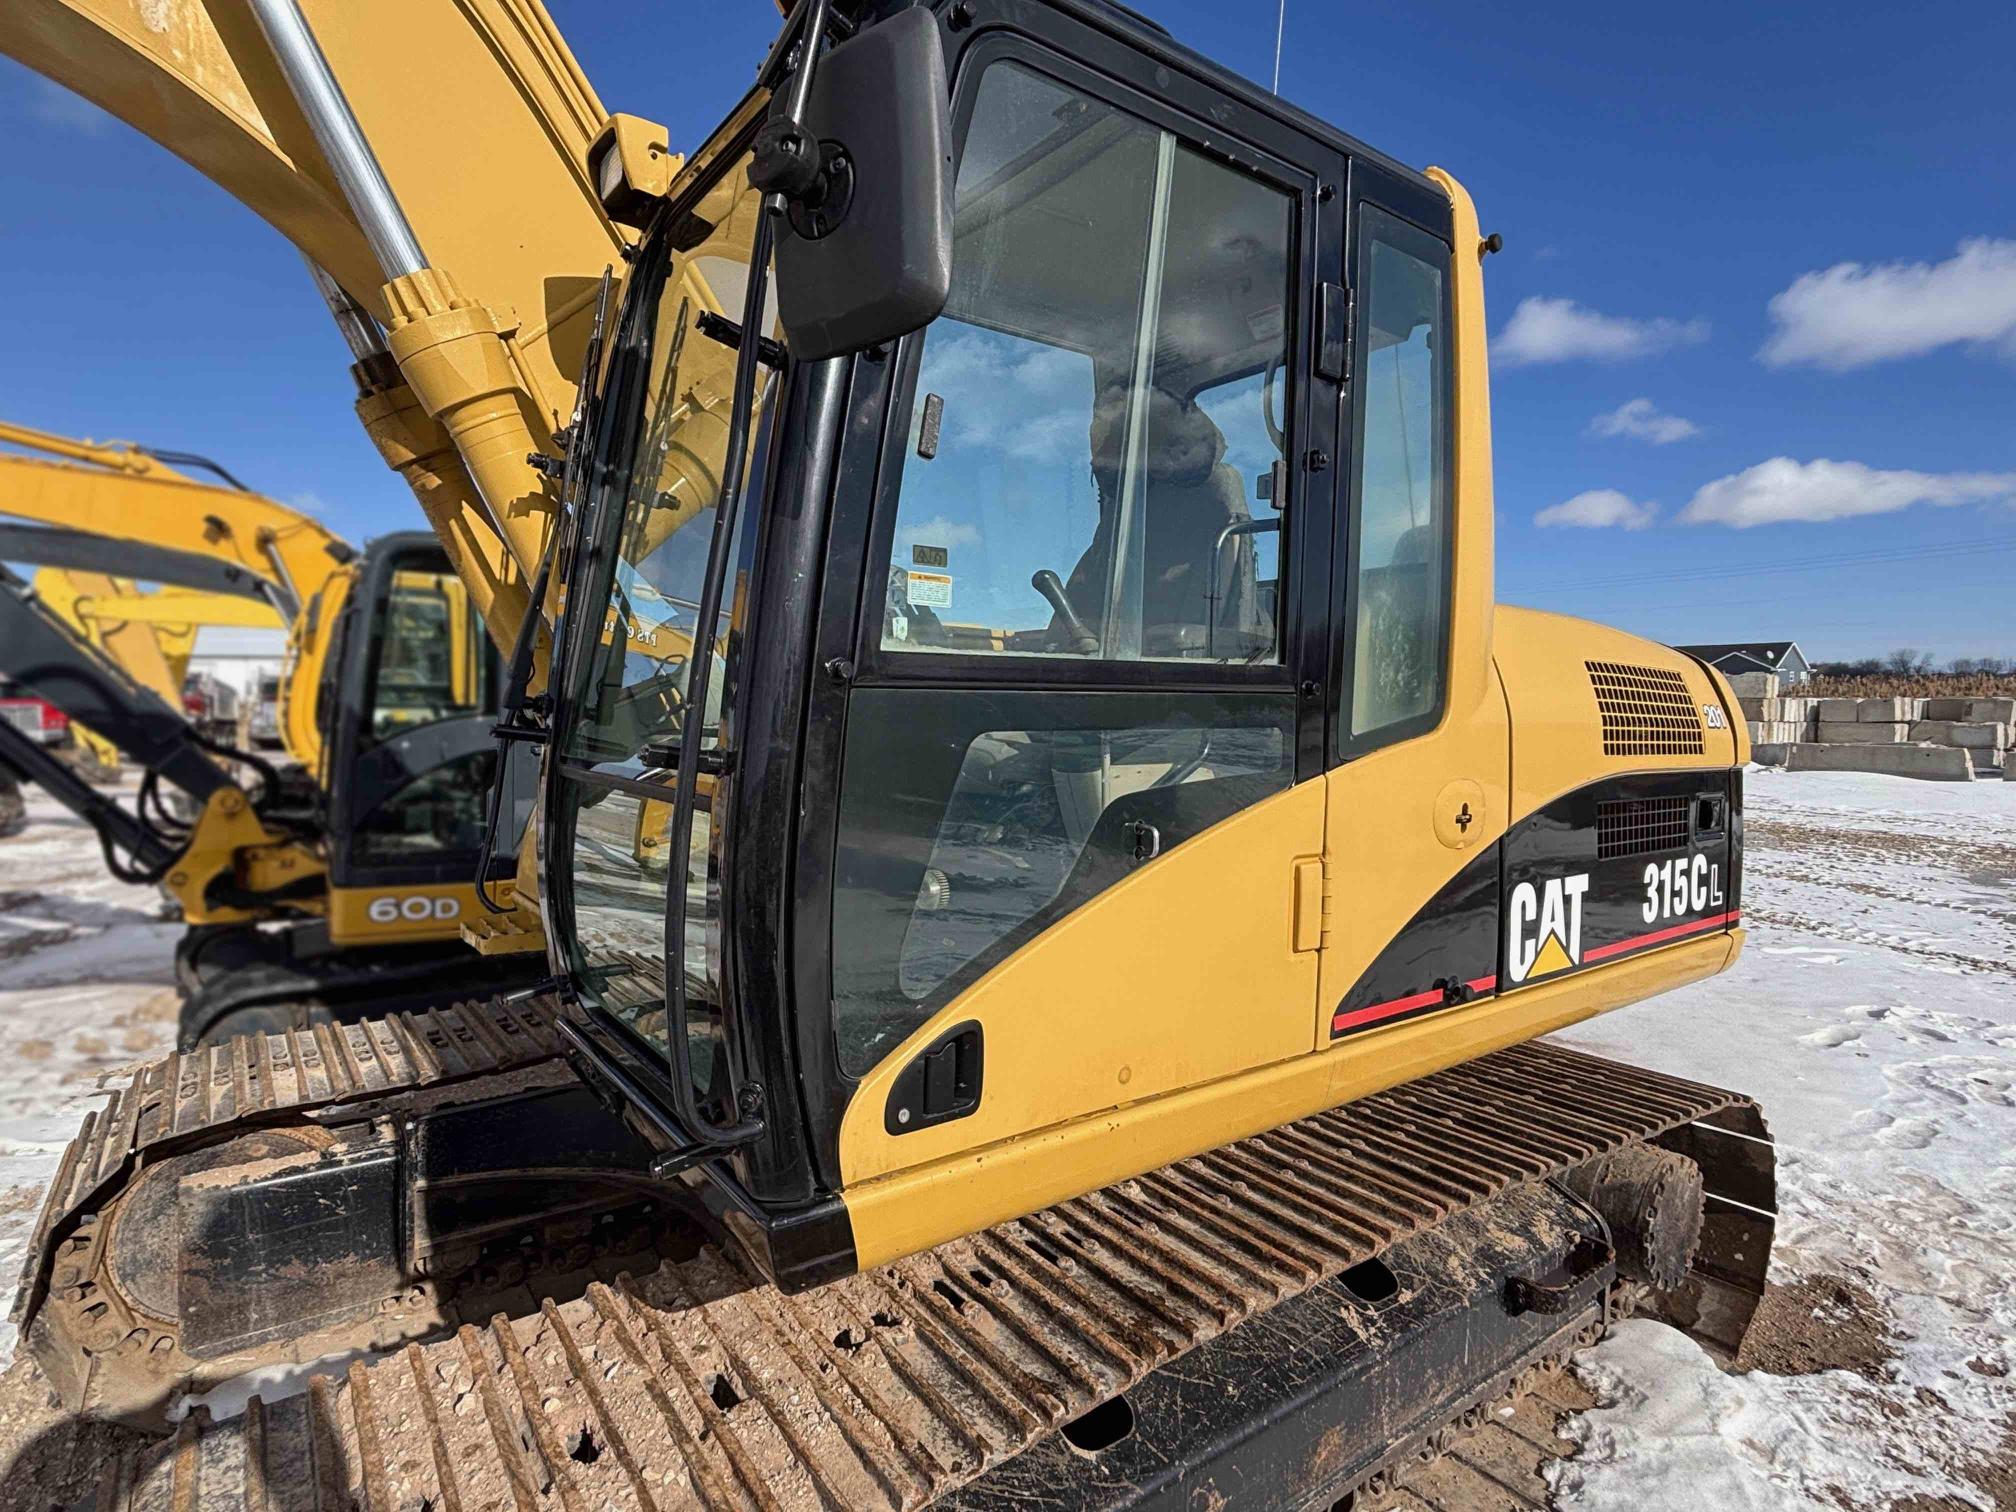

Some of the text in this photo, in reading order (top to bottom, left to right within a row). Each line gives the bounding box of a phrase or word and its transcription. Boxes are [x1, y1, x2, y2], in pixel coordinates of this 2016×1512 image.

[1703, 704, 1726, 728] 201
[369, 895, 460, 923] 60D
[1509, 873, 1589, 982] CAT
